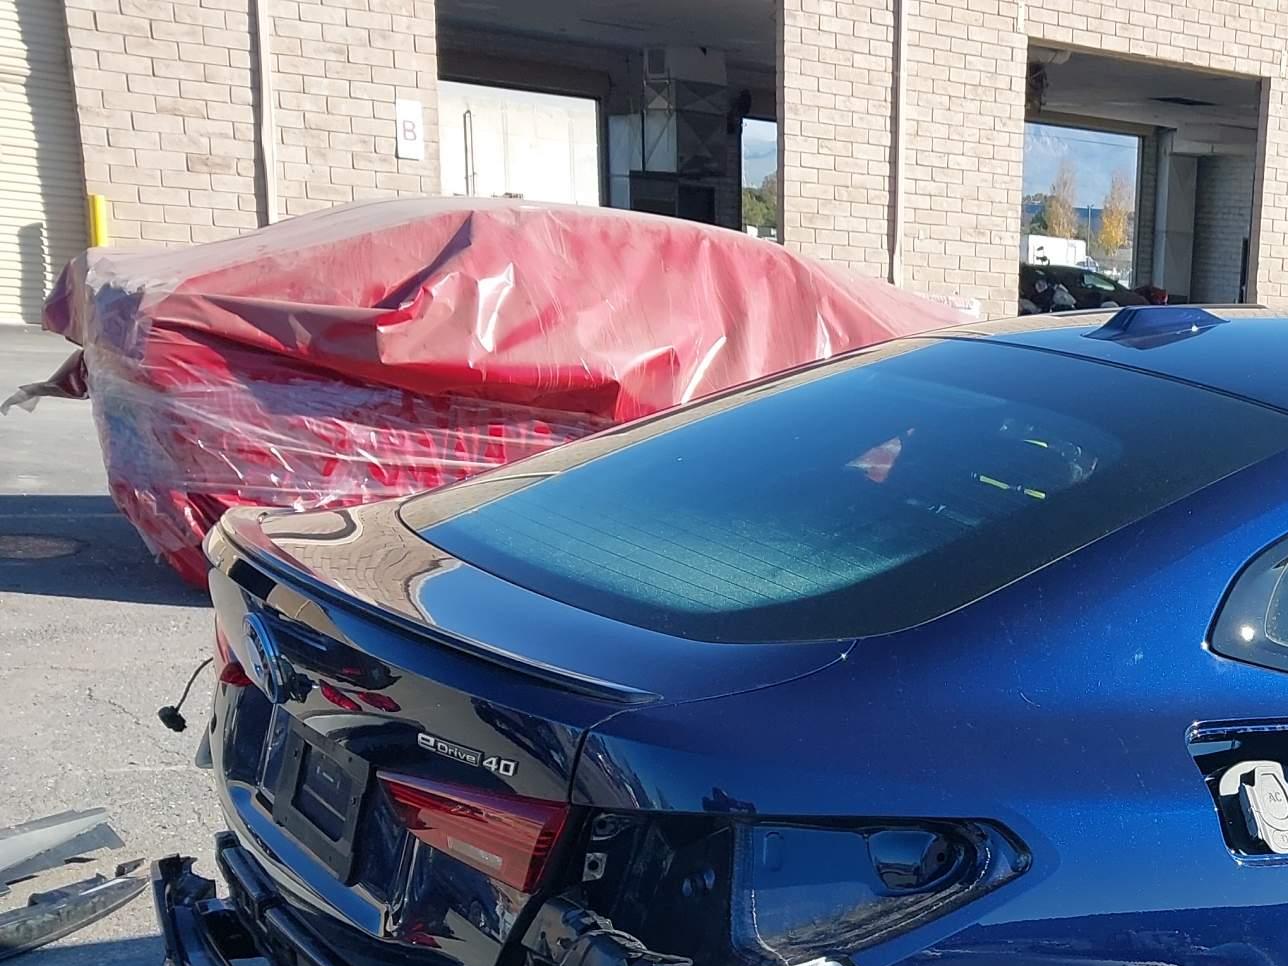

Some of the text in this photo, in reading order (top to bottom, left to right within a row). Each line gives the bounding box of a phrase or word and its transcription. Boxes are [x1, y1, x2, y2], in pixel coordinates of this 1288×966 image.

[403, 120, 416, 141] B
[483, 757, 516, 776] 40
[1268, 792, 1282, 802] AC
